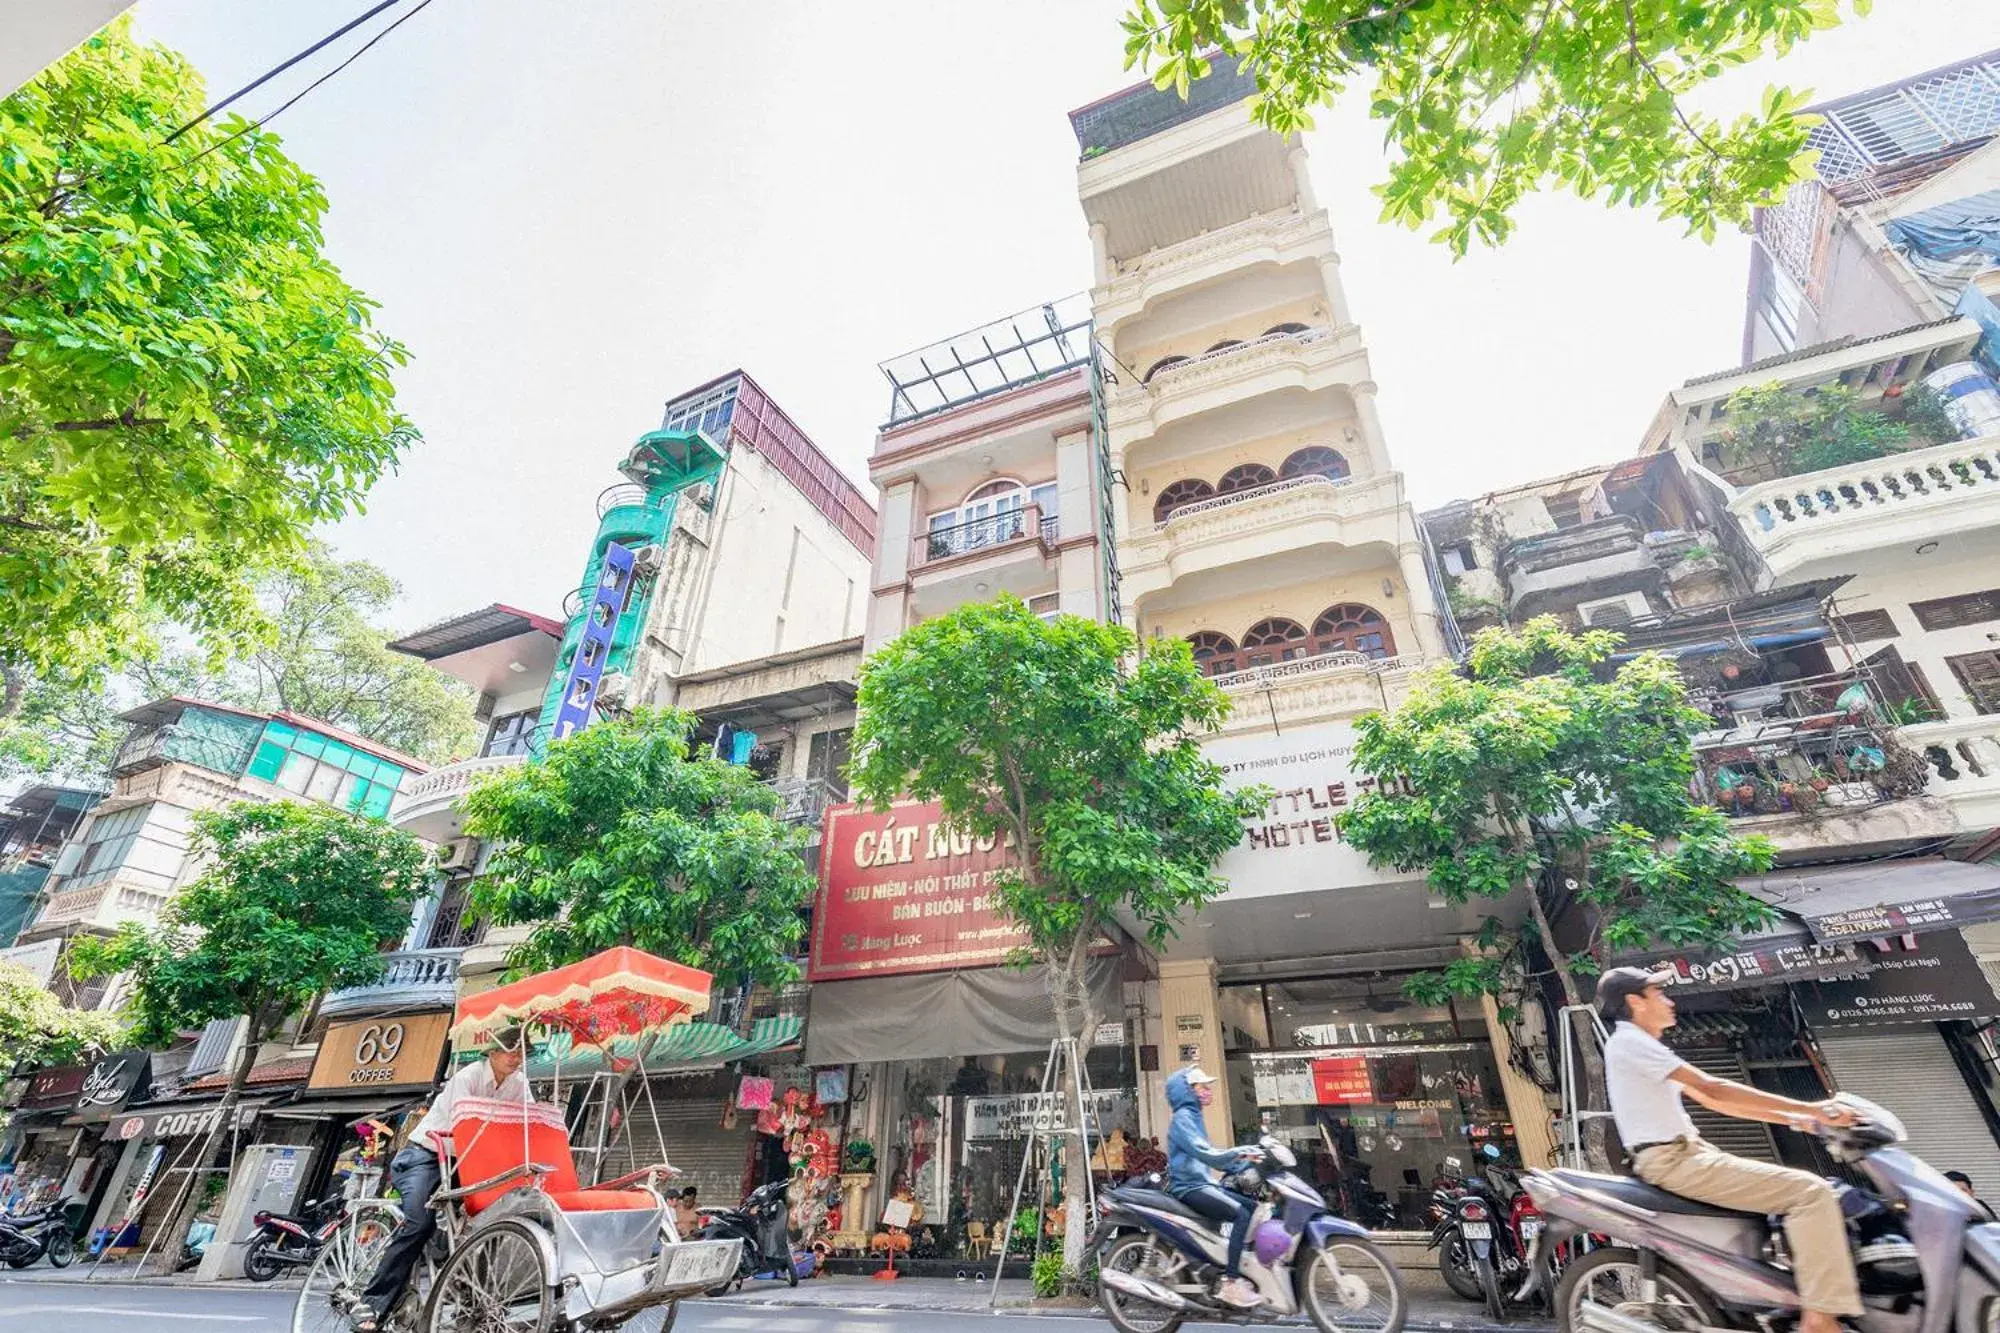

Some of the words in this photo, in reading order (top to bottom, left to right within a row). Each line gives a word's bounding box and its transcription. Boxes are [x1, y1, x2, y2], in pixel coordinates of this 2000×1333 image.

[854, 816, 919, 868] CÁT
[355, 1022, 404, 1065] 69
[349, 1068, 394, 1083] COFFEE
[1396, 1099, 1453, 1110] WELCOME
